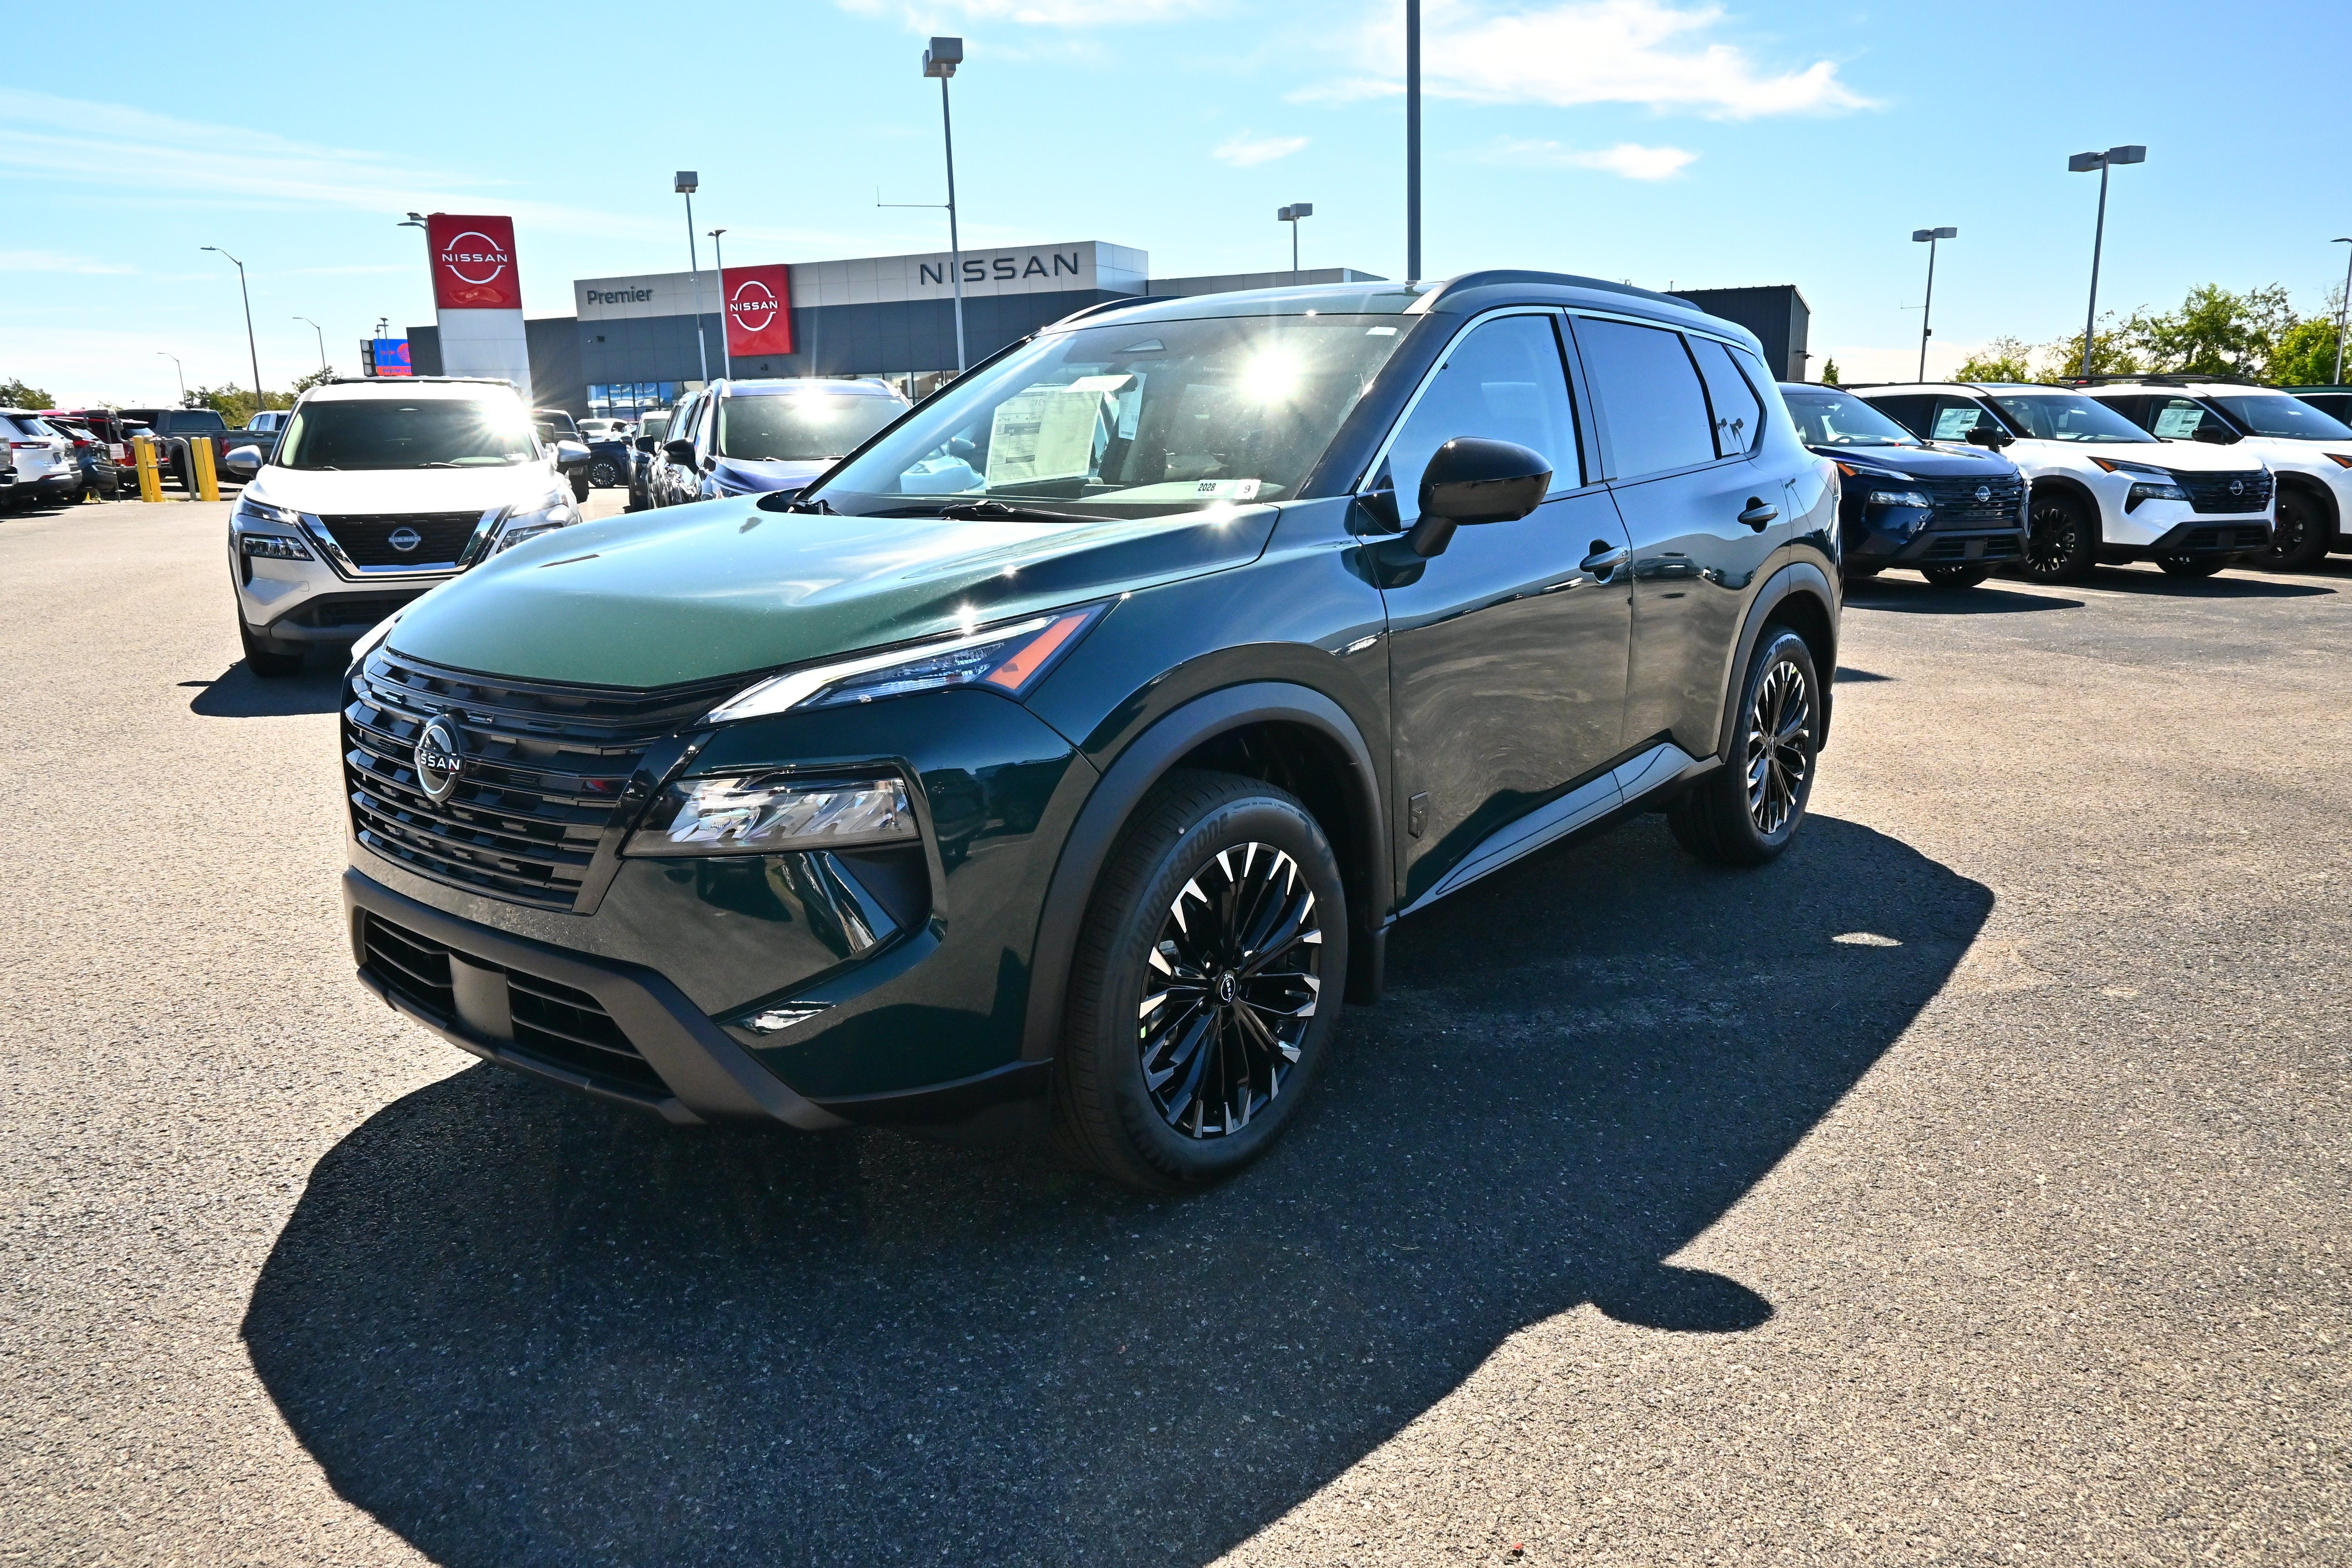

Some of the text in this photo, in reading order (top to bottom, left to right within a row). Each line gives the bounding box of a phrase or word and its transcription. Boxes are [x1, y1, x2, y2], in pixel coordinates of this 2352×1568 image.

[442, 253, 507, 262] NISSAN
[920, 253, 1078, 285] NISSAN
[587, 286, 653, 305] Premier
[730, 300, 778, 311] NISSAN
[1198, 483, 1216, 491] 2028
[418, 751, 460, 770] SSAN
